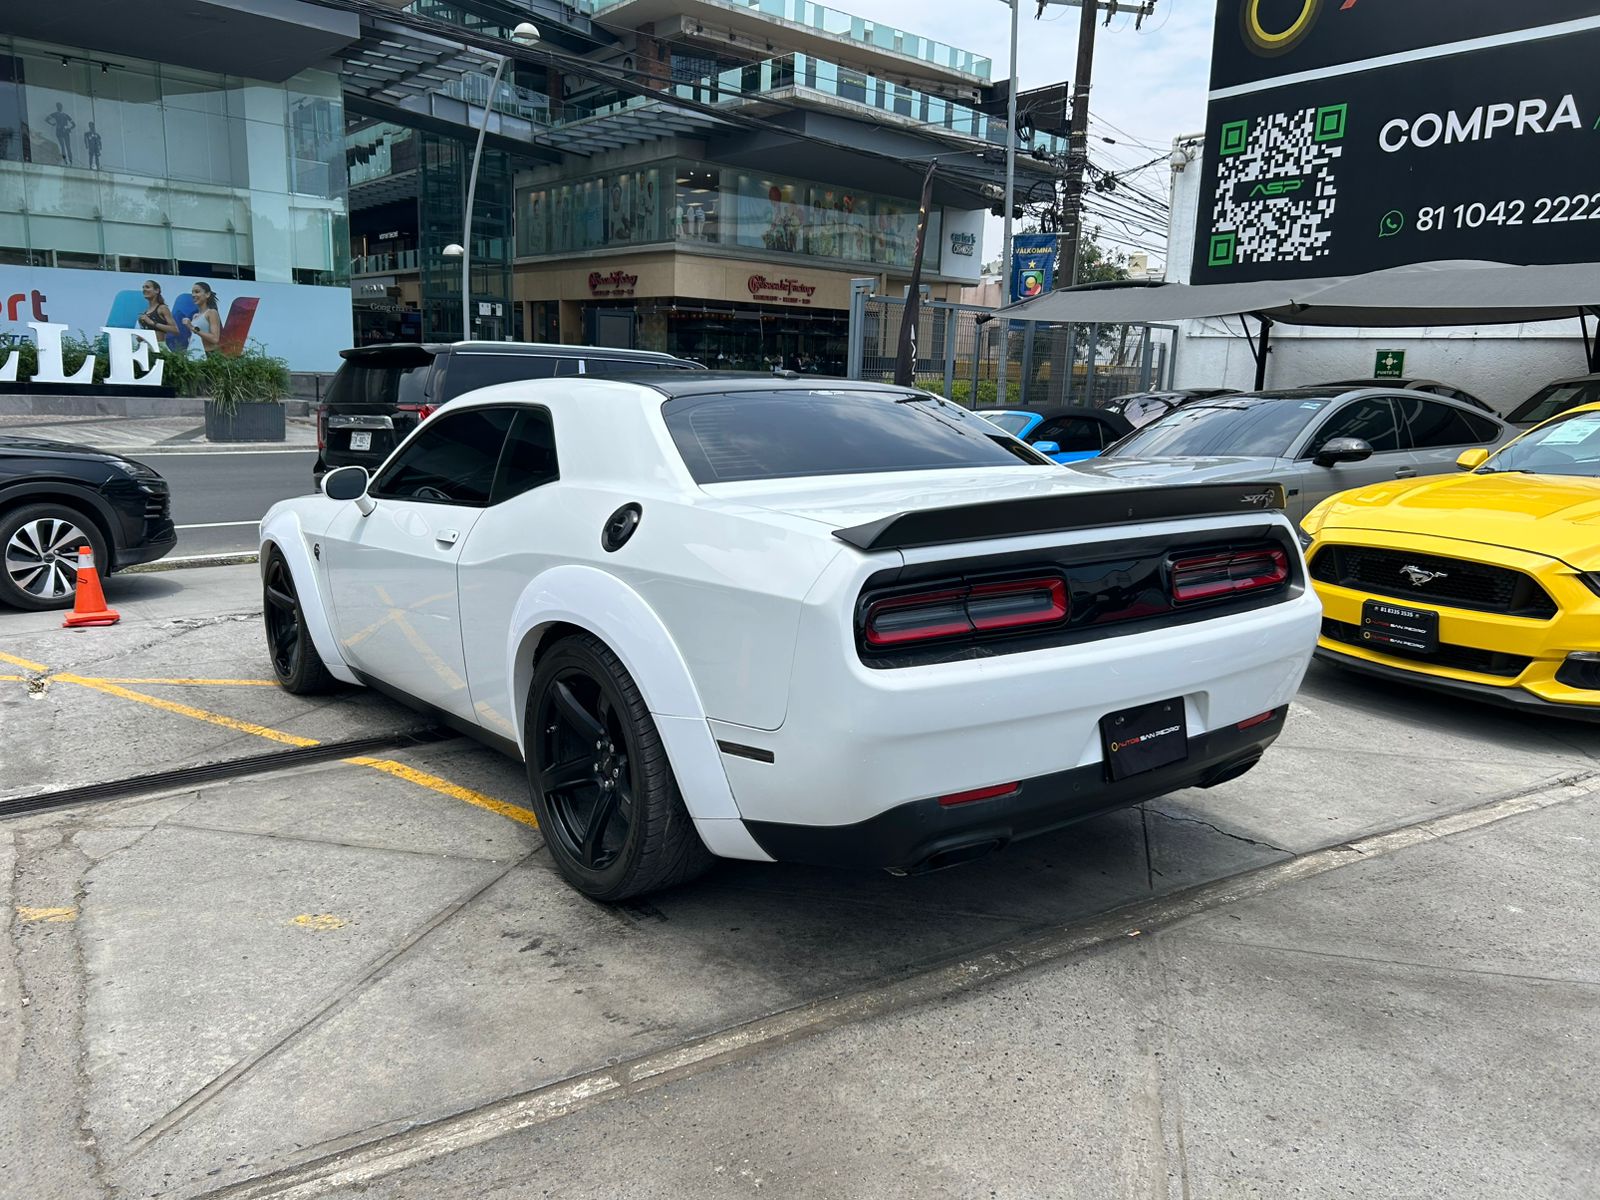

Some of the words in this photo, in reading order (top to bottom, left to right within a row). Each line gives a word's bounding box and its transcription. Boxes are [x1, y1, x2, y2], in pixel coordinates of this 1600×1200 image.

[1378, 94, 1583, 153] COMPRA
[1416, 205, 1445, 232] 81
[1452, 200, 1525, 230] 1042
[1532, 192, 1600, 225] 2222
[0, 290, 48, 322] rt
